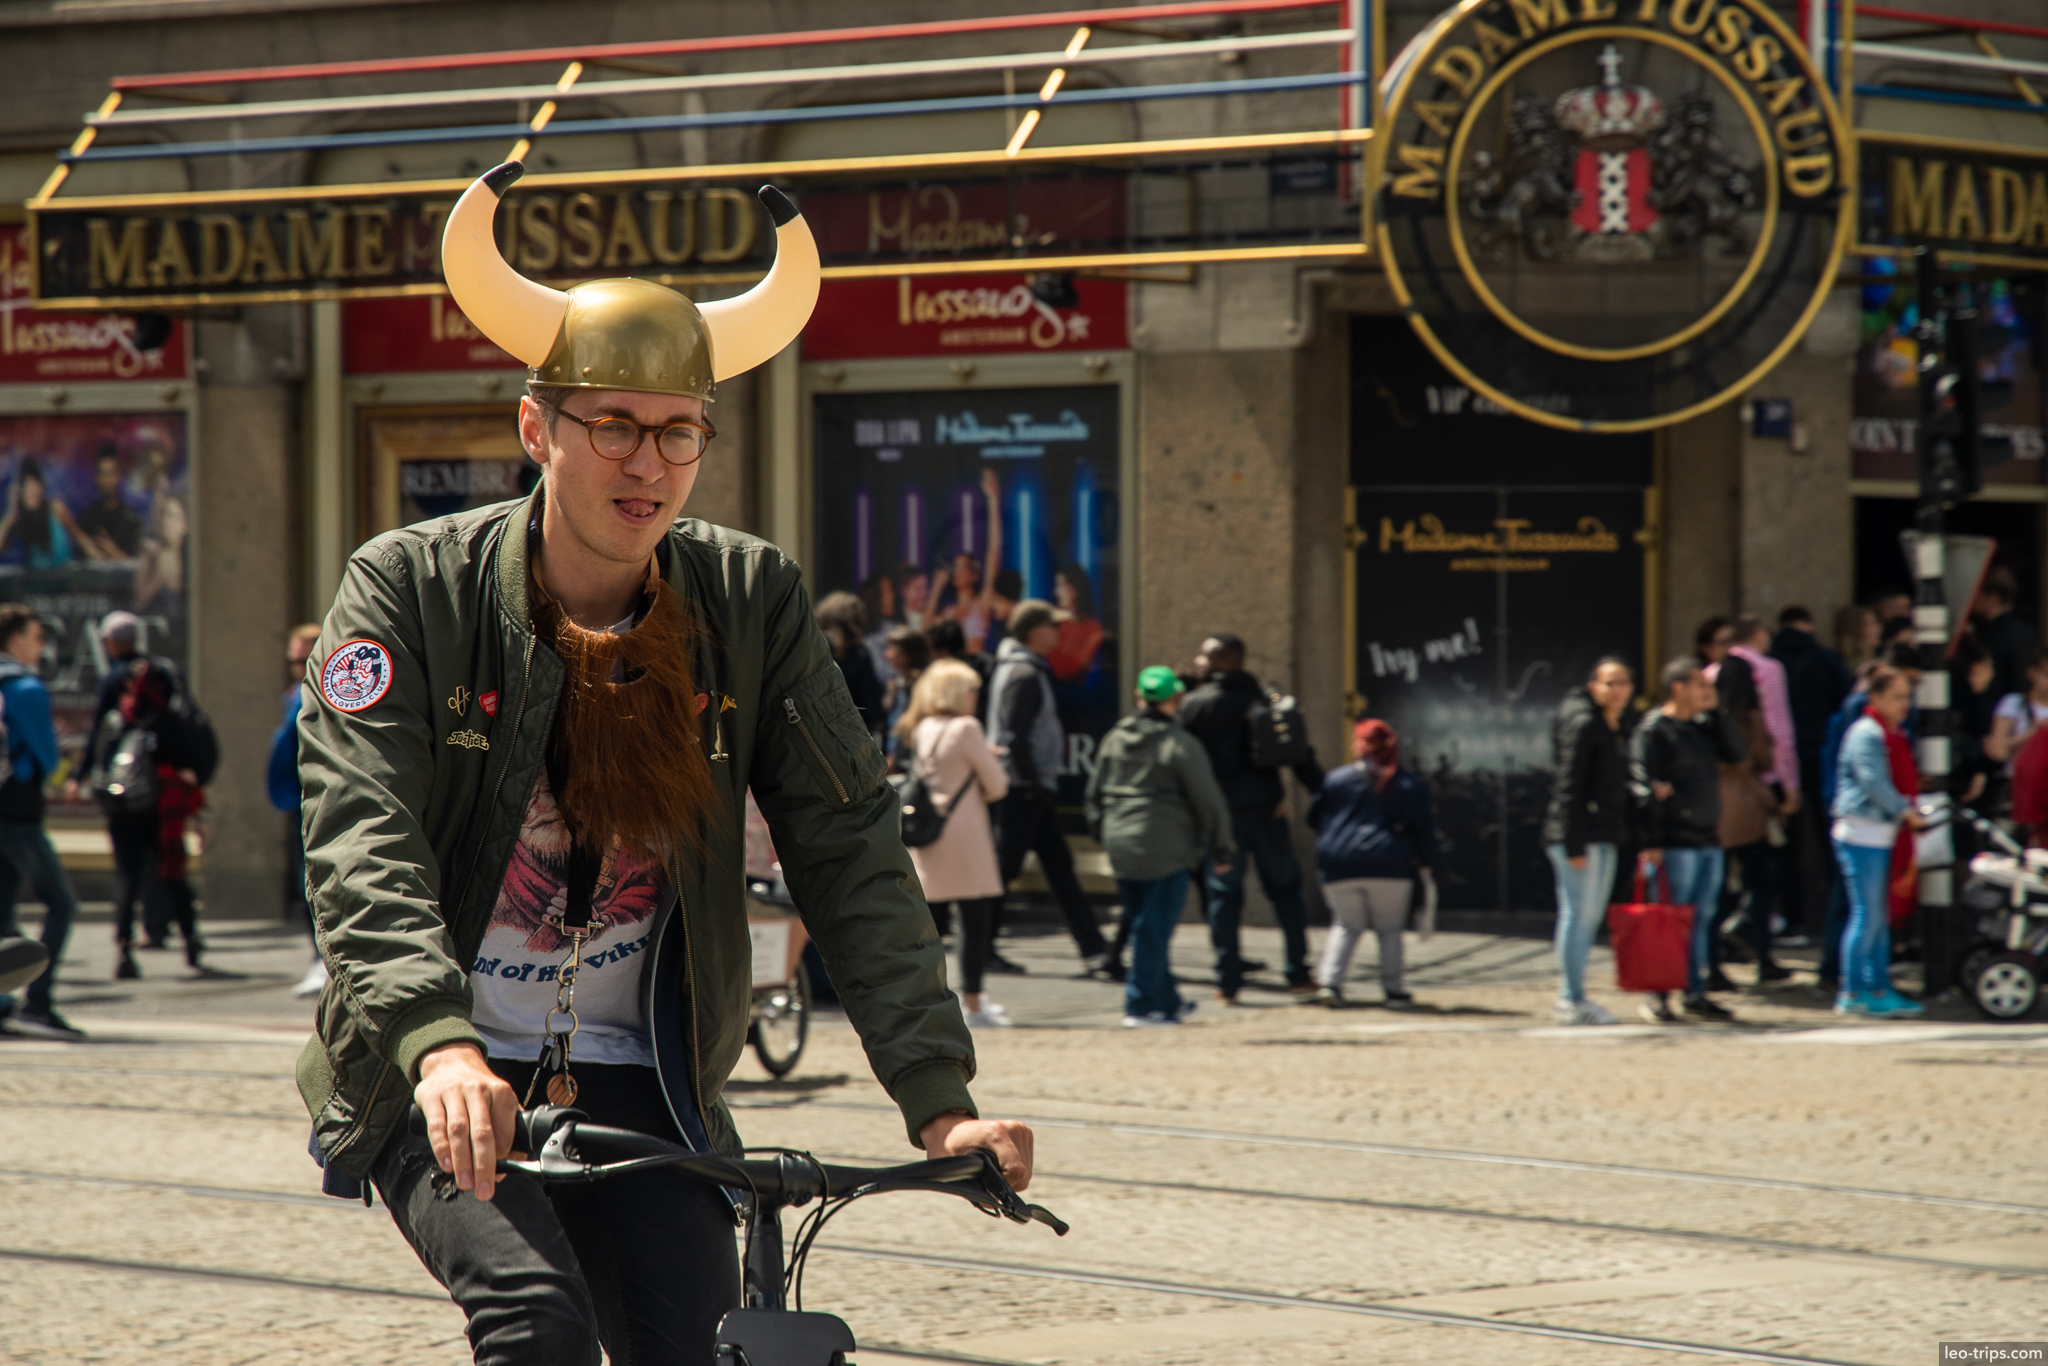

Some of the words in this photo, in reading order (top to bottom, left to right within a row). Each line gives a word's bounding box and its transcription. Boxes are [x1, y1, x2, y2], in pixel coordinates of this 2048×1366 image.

[87, 209, 396, 289] MADAME
[1379, 513, 1498, 553] Madame
[1493, 516, 1619, 552] Tussauds
[1369, 641, 1421, 683] Try
[1424, 616, 1482, 663] me!
[322, 669, 334, 699] RAMEN
[334, 698, 367, 708] LOVERS
[368, 680, 386, 700] CLUB
[500, 963, 536, 982] of
